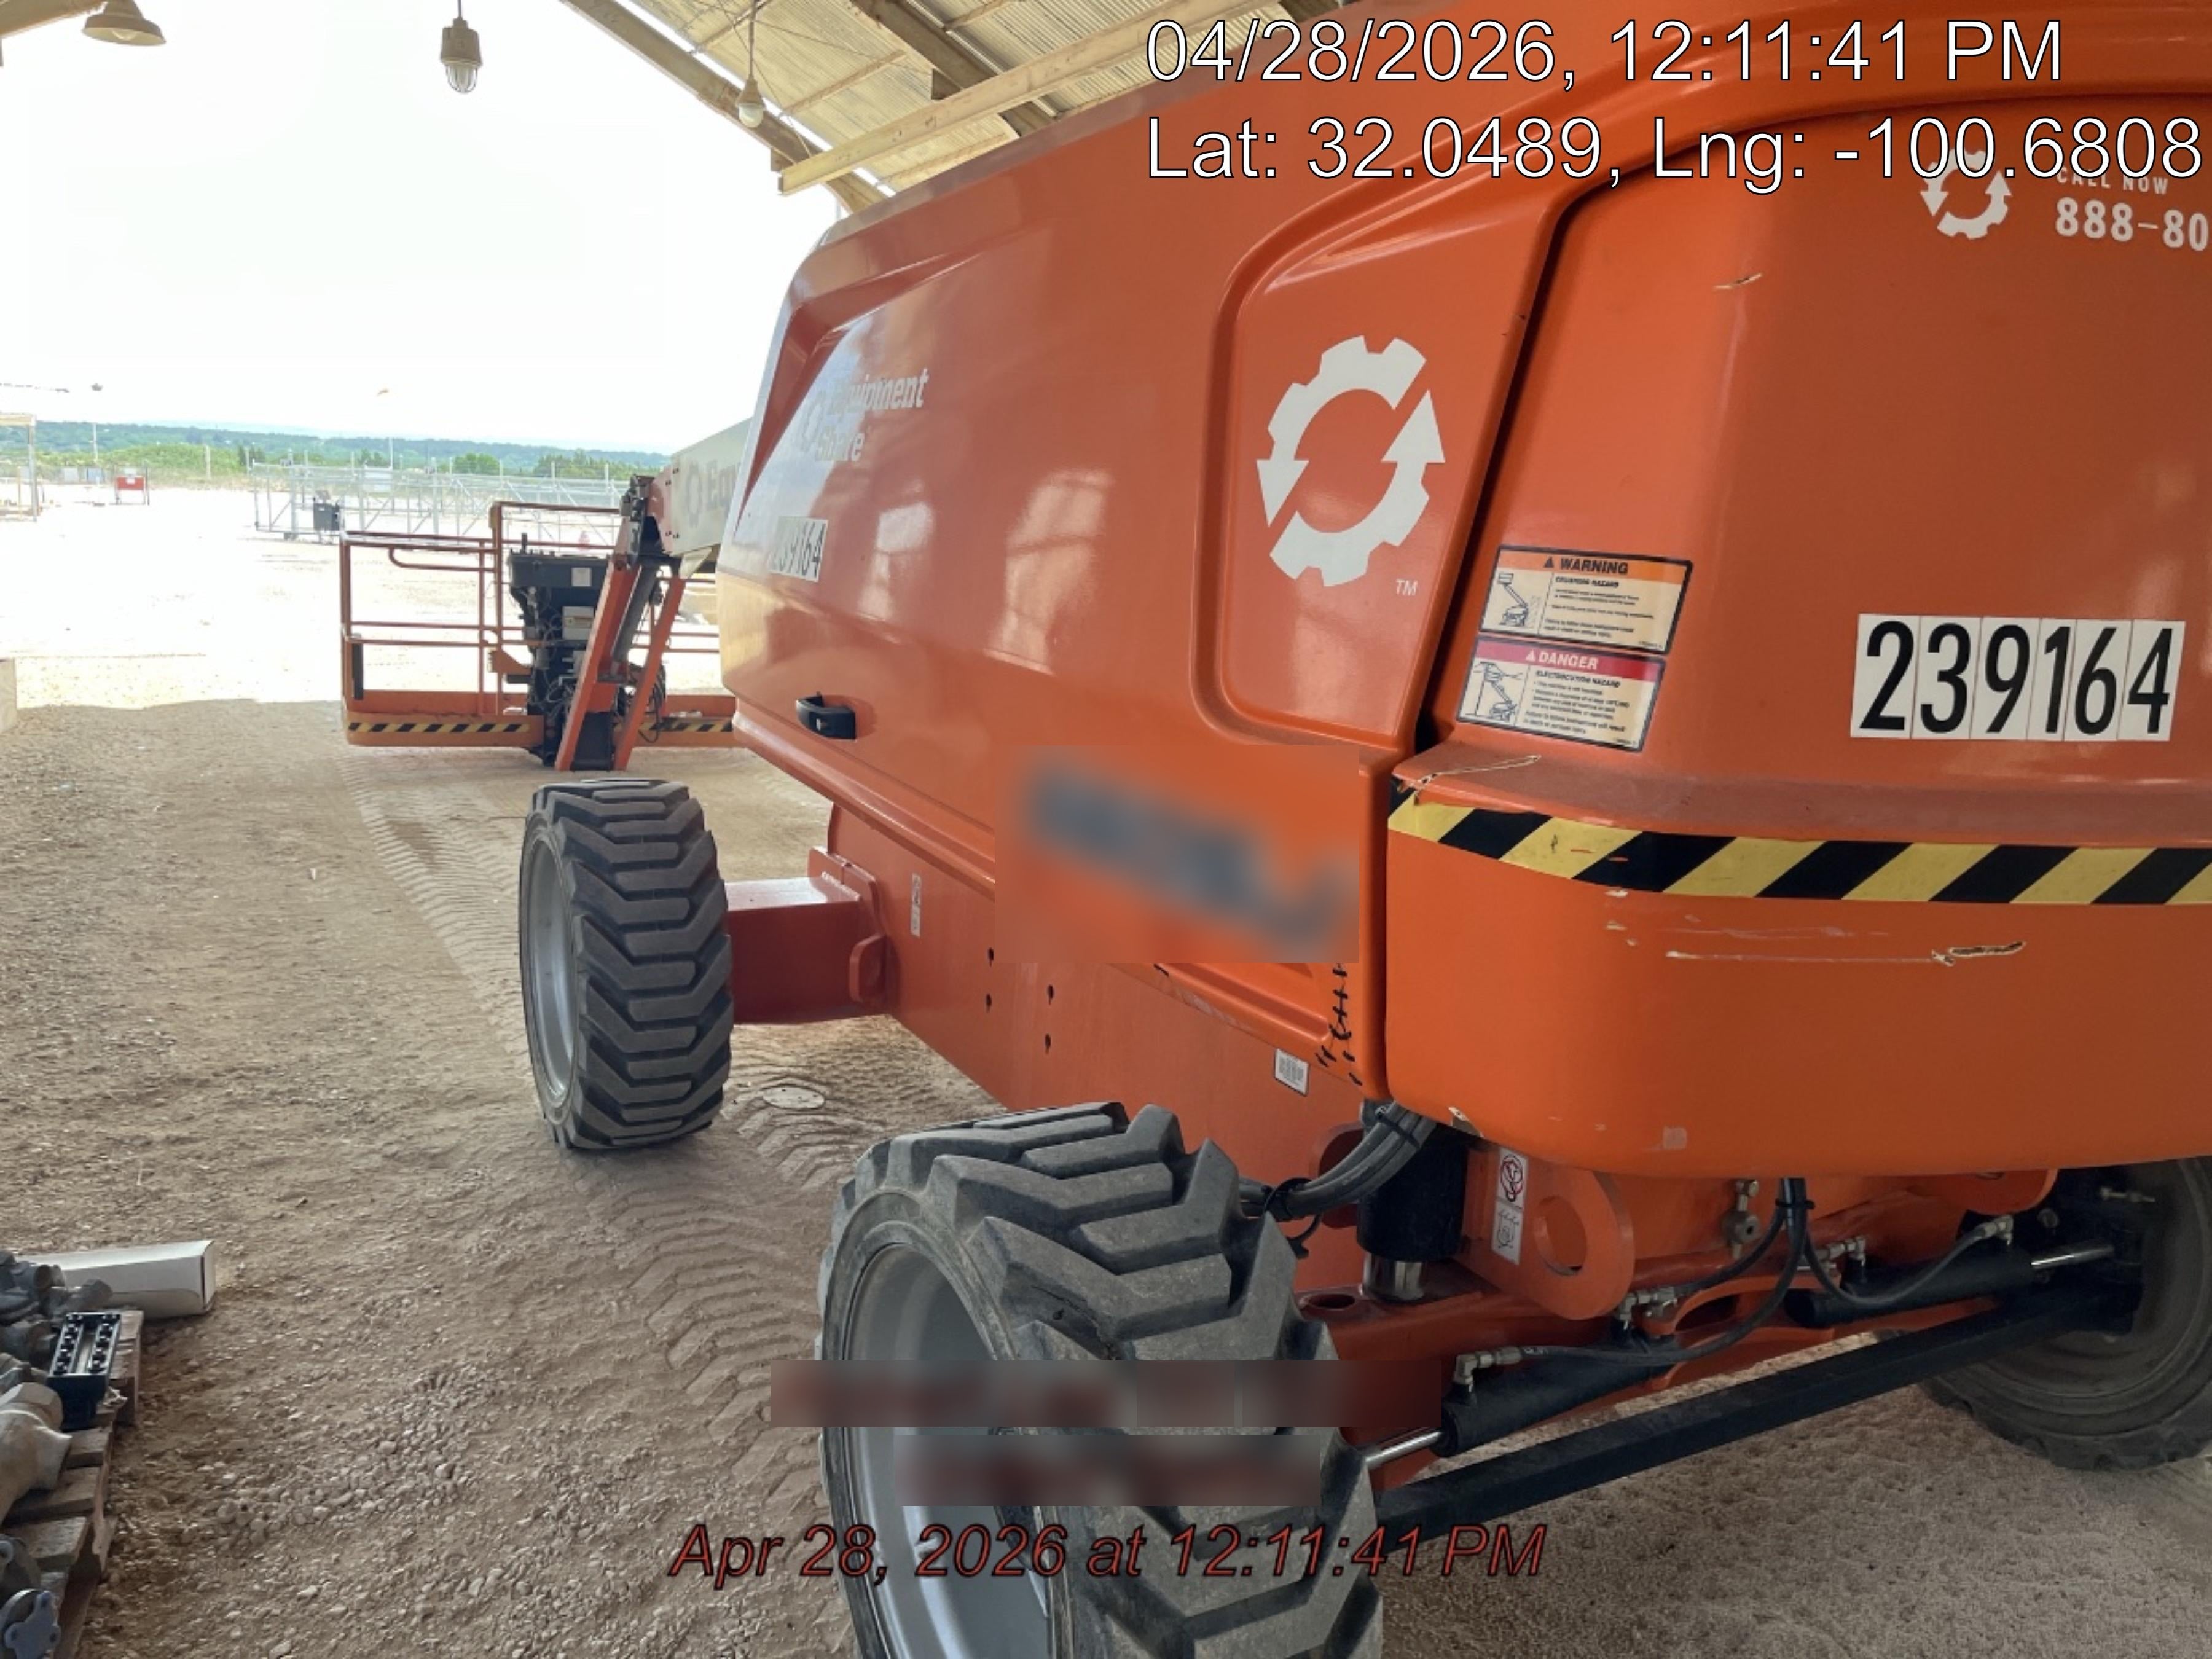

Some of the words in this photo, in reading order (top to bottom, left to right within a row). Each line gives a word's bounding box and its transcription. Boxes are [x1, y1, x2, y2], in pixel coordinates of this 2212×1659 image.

[2123, 172, 2168, 195] NOW
[2055, 197, 2209, 251] 888-80
[1561, 557, 1628, 575] WARNING
[1396, 579, 1418, 595] TM
[1539, 650, 1598, 670] DANGER
[1859, 620, 2173, 735] 239164
